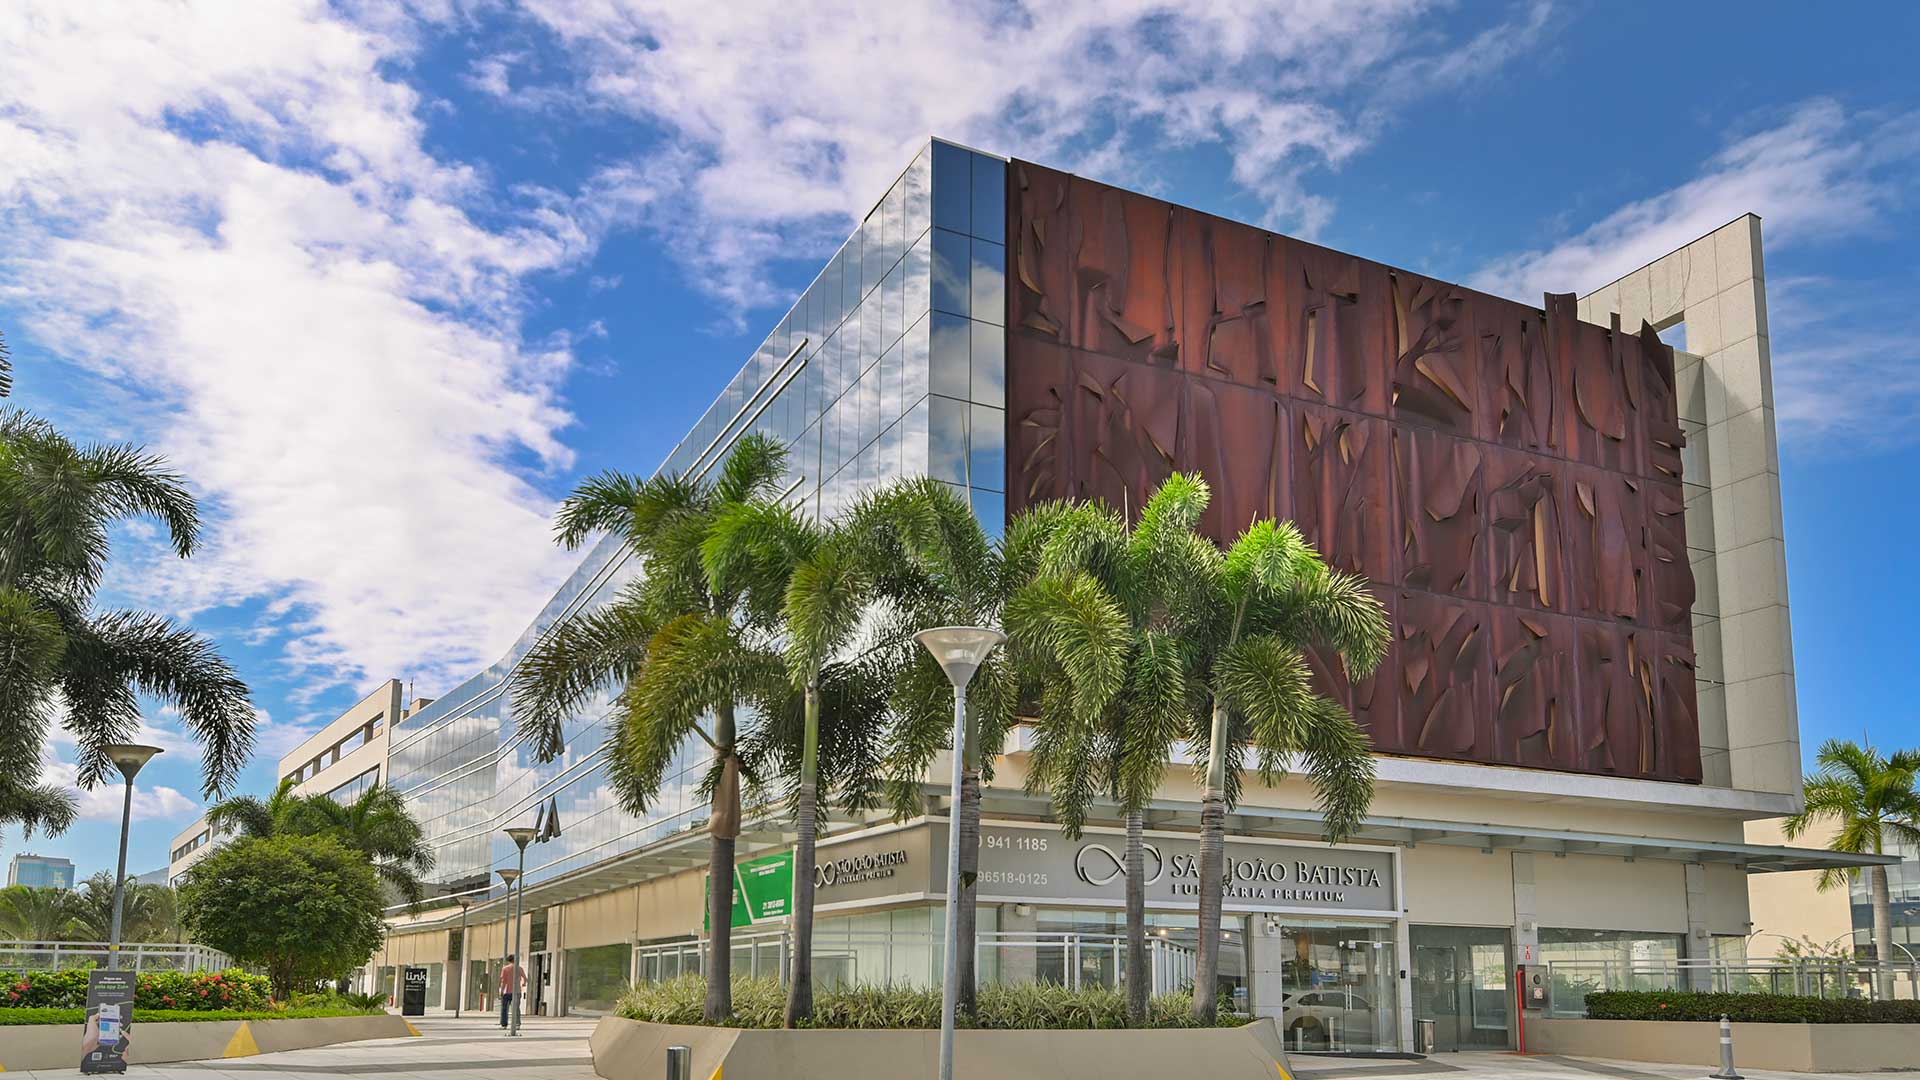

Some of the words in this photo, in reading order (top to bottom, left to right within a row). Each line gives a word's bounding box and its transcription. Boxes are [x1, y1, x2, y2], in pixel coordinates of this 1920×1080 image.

[987, 835, 1010, 849] 941
[1016, 837, 1048, 851] 1185
[837, 857, 851, 874] SÃO
[851, 854, 872, 873] JOÃO
[874, 850, 905, 868] BATISTA
[977, 871, 1048, 885] 96518-0125
[1171, 854, 1200, 879] SÃ
[1226, 857, 1287, 885] JOÃO
[1297, 861, 1381, 888] BATISTA
[1273, 888, 1345, 902] PREMIUM
